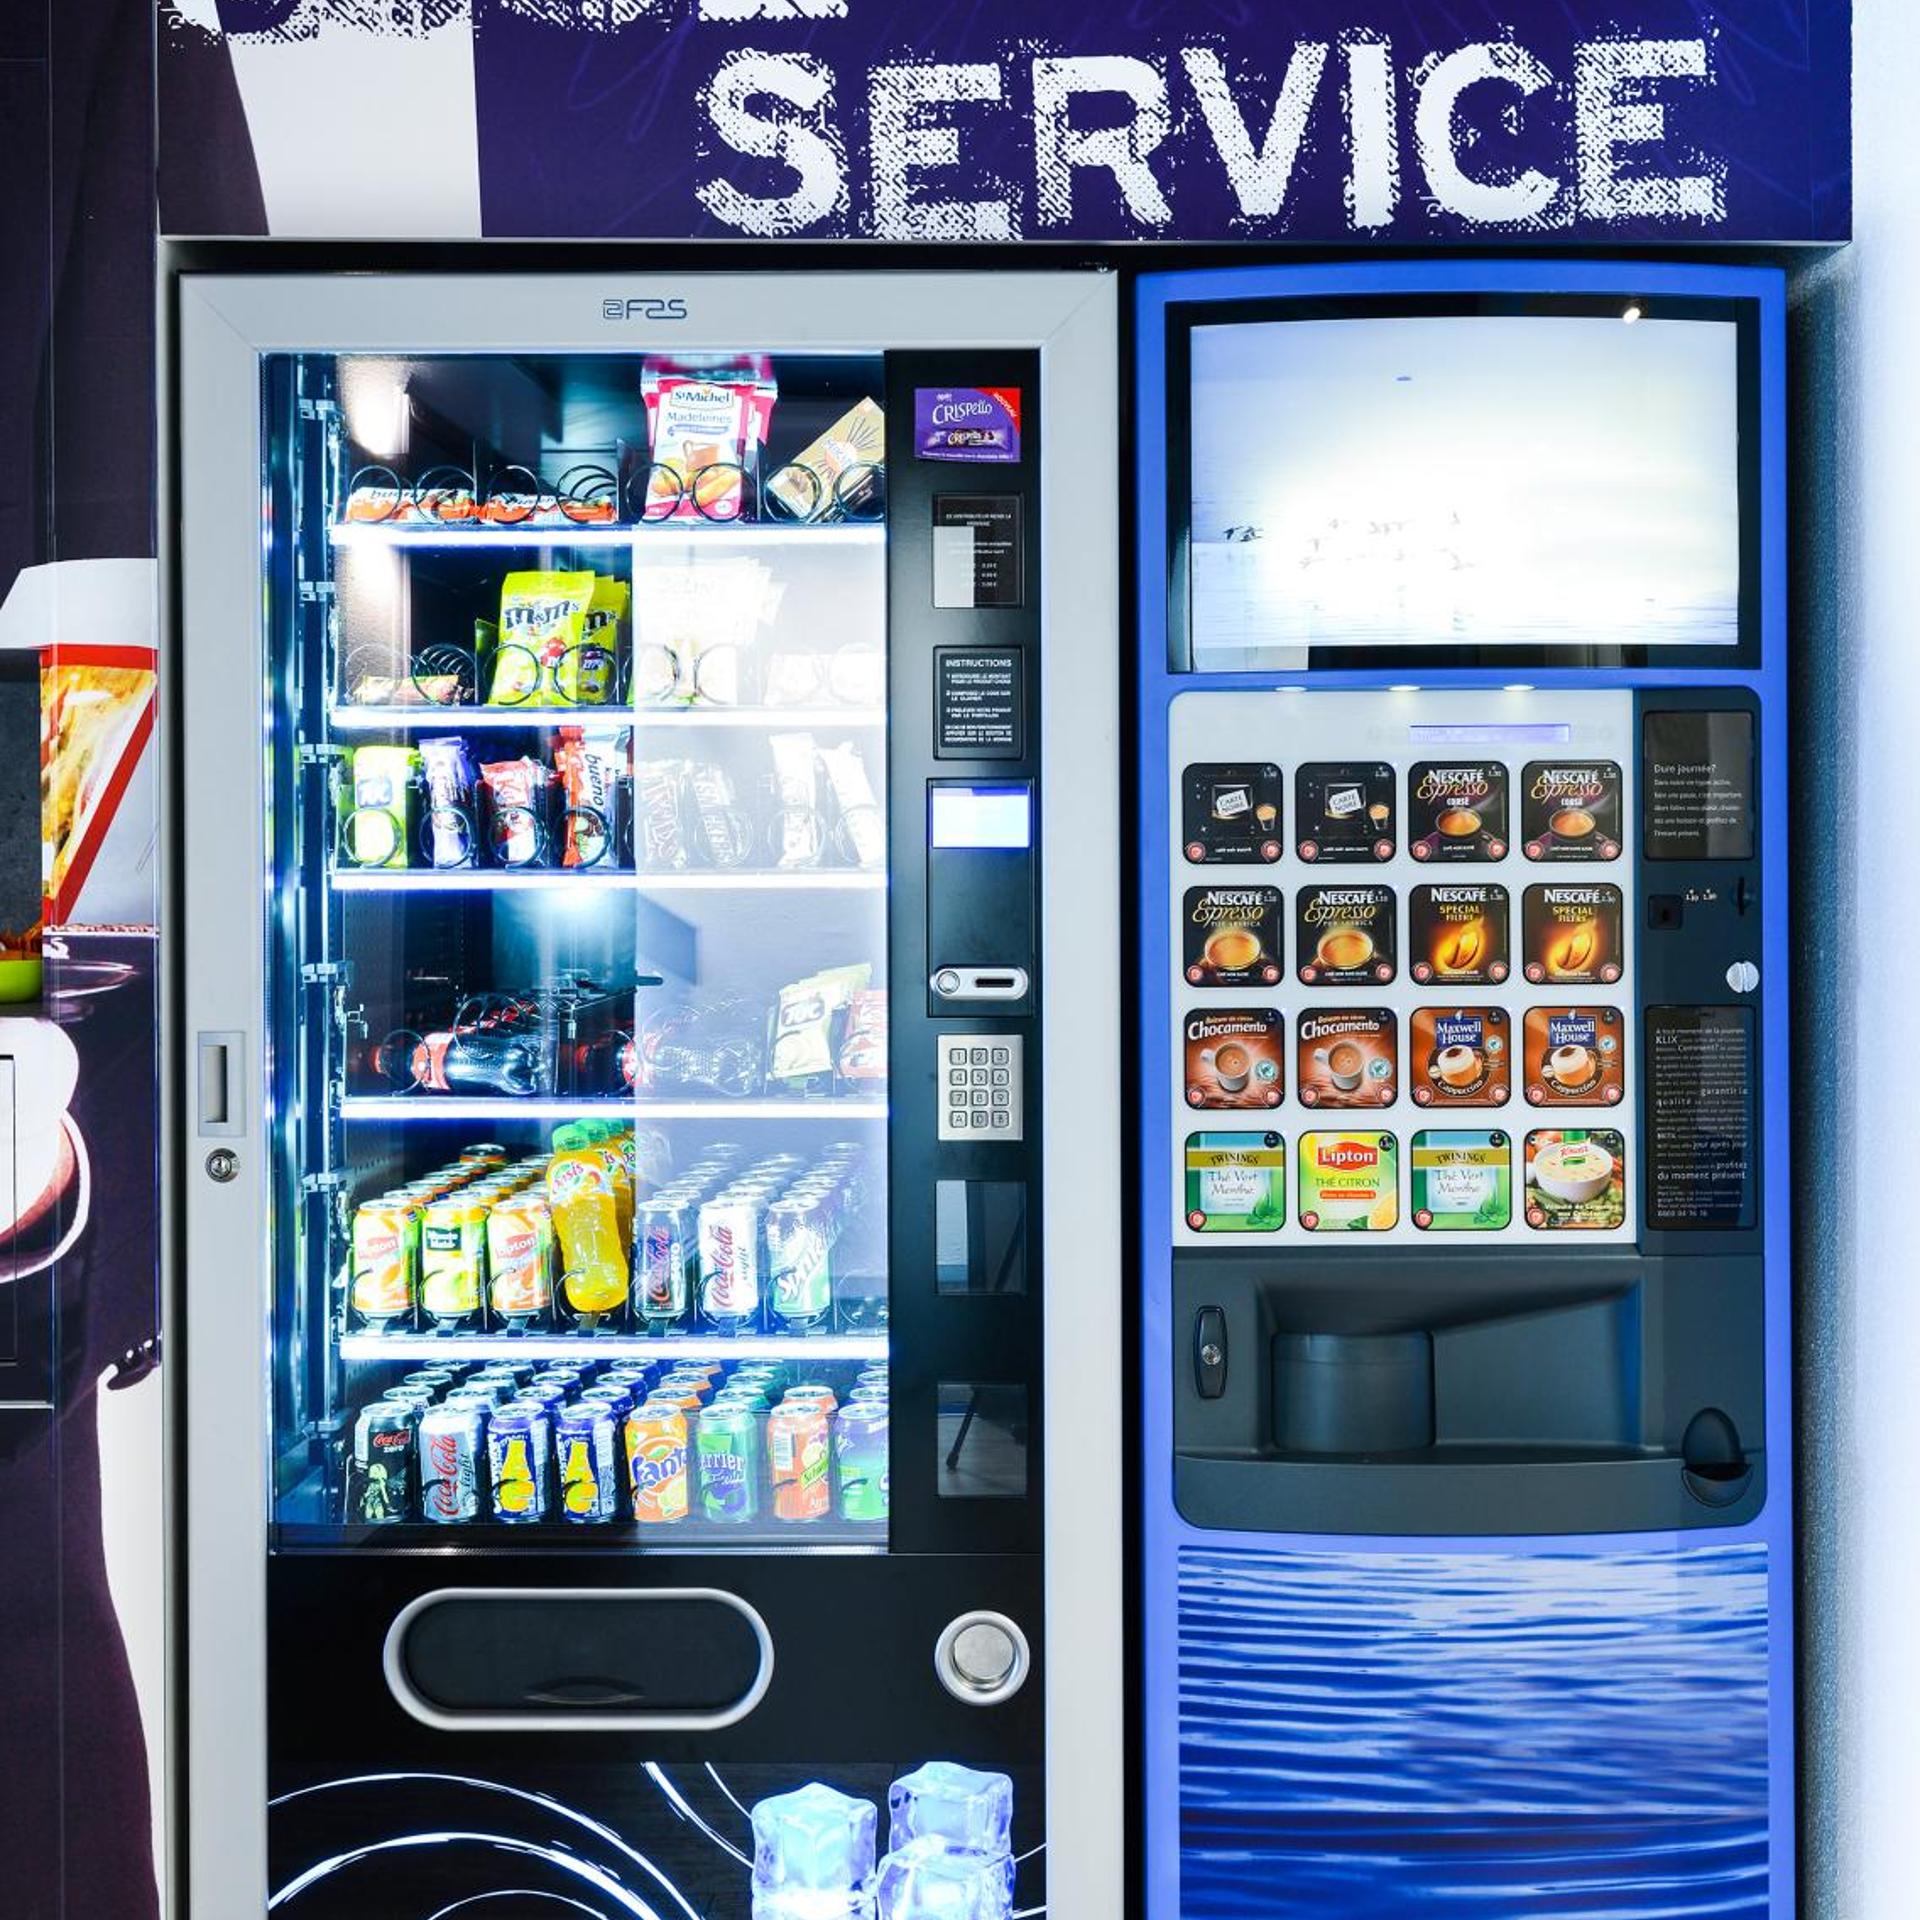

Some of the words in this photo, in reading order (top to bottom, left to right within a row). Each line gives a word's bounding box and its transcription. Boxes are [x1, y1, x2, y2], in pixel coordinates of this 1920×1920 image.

[695, 25, 1728, 242] SERVICE
[945, 659, 1012, 667] INSTRUCTIONS
[585, 754, 604, 806] bueno
[1429, 768, 1484, 784] NESCAFÉ
[1542, 769, 1598, 784] NESCAFÉ
[1417, 776, 1489, 806] Espresso
[1530, 776, 1604, 806] Espresso
[1207, 891, 1264, 906] NESCAFÉ
[1319, 890, 1375, 906] NESCAFÉ
[1431, 887, 1488, 902] NESCAFÉ
[1543, 888, 1600, 904] NESCAFÉ
[1192, 899, 1264, 929] Espresso
[1304, 899, 1377, 929] Espresso
[1188, 1020, 1267, 1041] Chocamento
[1301, 1019, 1380, 1041] Chocamento
[1437, 1020, 1481, 1034] Maxwell
[1551, 1020, 1595, 1034] Maxwell
[1442, 1032, 1476, 1044] House
[1556, 1032, 1589, 1043] House
[1656, 1036, 1678, 1045] KLIX
[1209, 1151, 1261, 1166] TWININGS
[1322, 1149, 1374, 1164] Lipton
[1436, 1151, 1488, 1165] TWININGS
[1208, 1170, 1231, 1183] Thé
[1233, 1171, 1258, 1182] Vert
[1338, 1177, 1380, 1188] CITRON
[1434, 1169, 1458, 1182] Thé
[1460, 1170, 1484, 1182] Vert
[708, 1223, 735, 1307] Coca-Cola
[632, 1446, 689, 1487] Fanta
[430, 1433, 460, 1516] Coca-Cola
